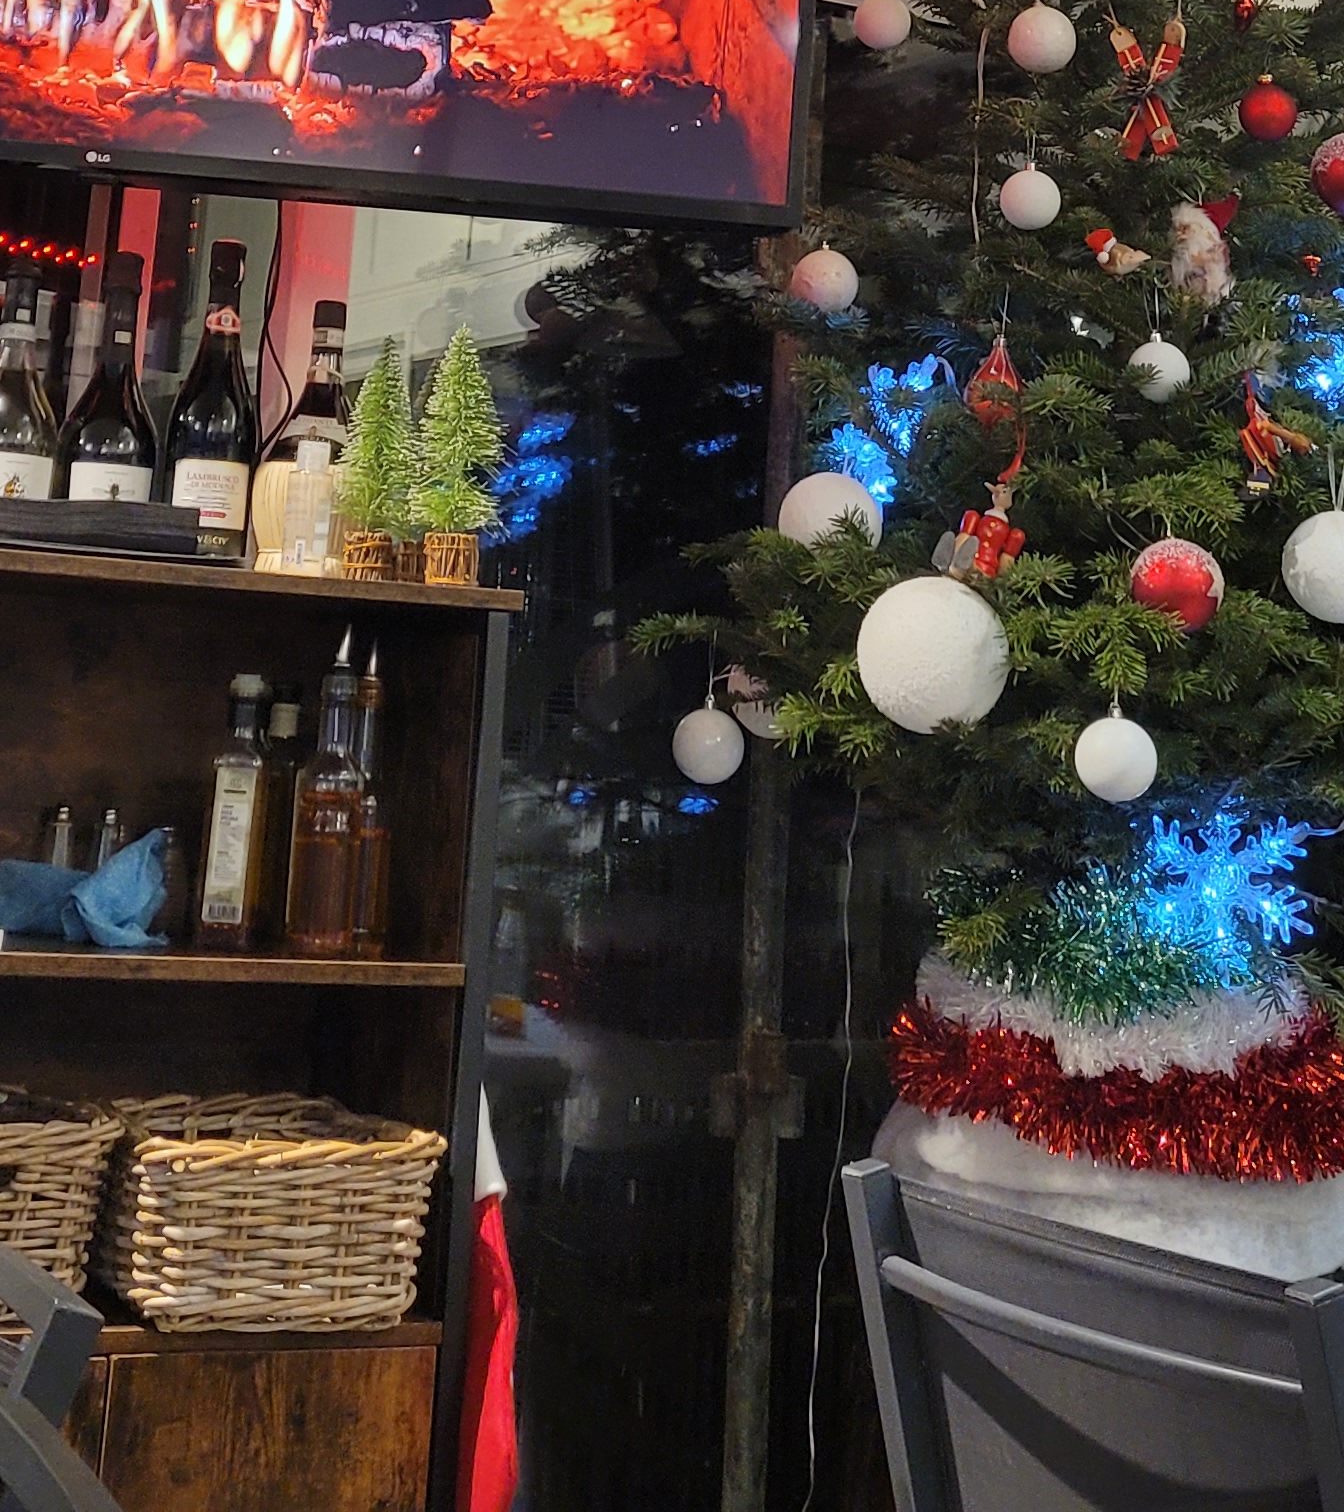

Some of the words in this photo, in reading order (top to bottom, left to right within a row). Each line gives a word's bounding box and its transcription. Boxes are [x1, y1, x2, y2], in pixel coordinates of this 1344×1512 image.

[186, 472, 239, 484] LAMBRUSCO
[190, 481, 200, 489] DI
[201, 482, 236, 492] MODENA
